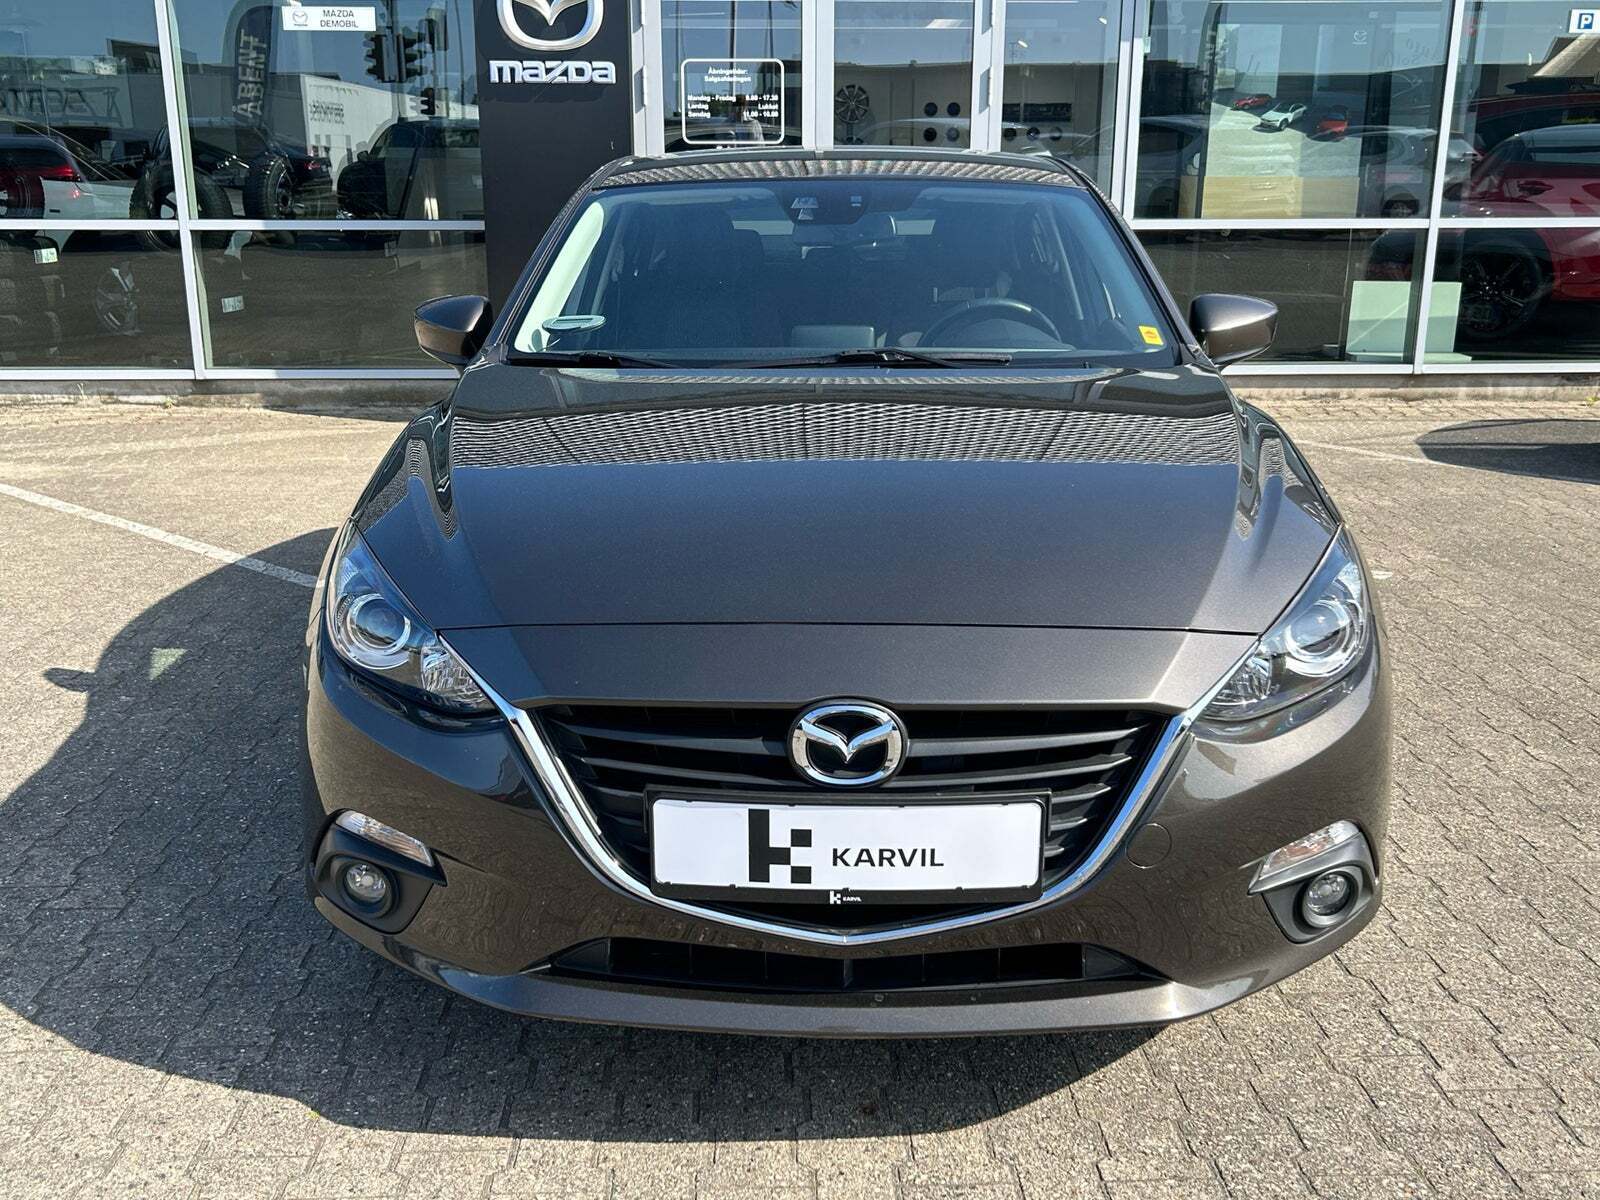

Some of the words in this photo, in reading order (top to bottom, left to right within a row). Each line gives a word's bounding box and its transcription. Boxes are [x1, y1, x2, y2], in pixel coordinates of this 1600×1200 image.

[322, 9, 354, 18] MAZDA
[320, 19, 359, 28] DEMOBIL
[687, 94, 711, 102] Mandag
[715, 94, 737, 102] Fredag
[832, 847, 945, 867] KARVIL
